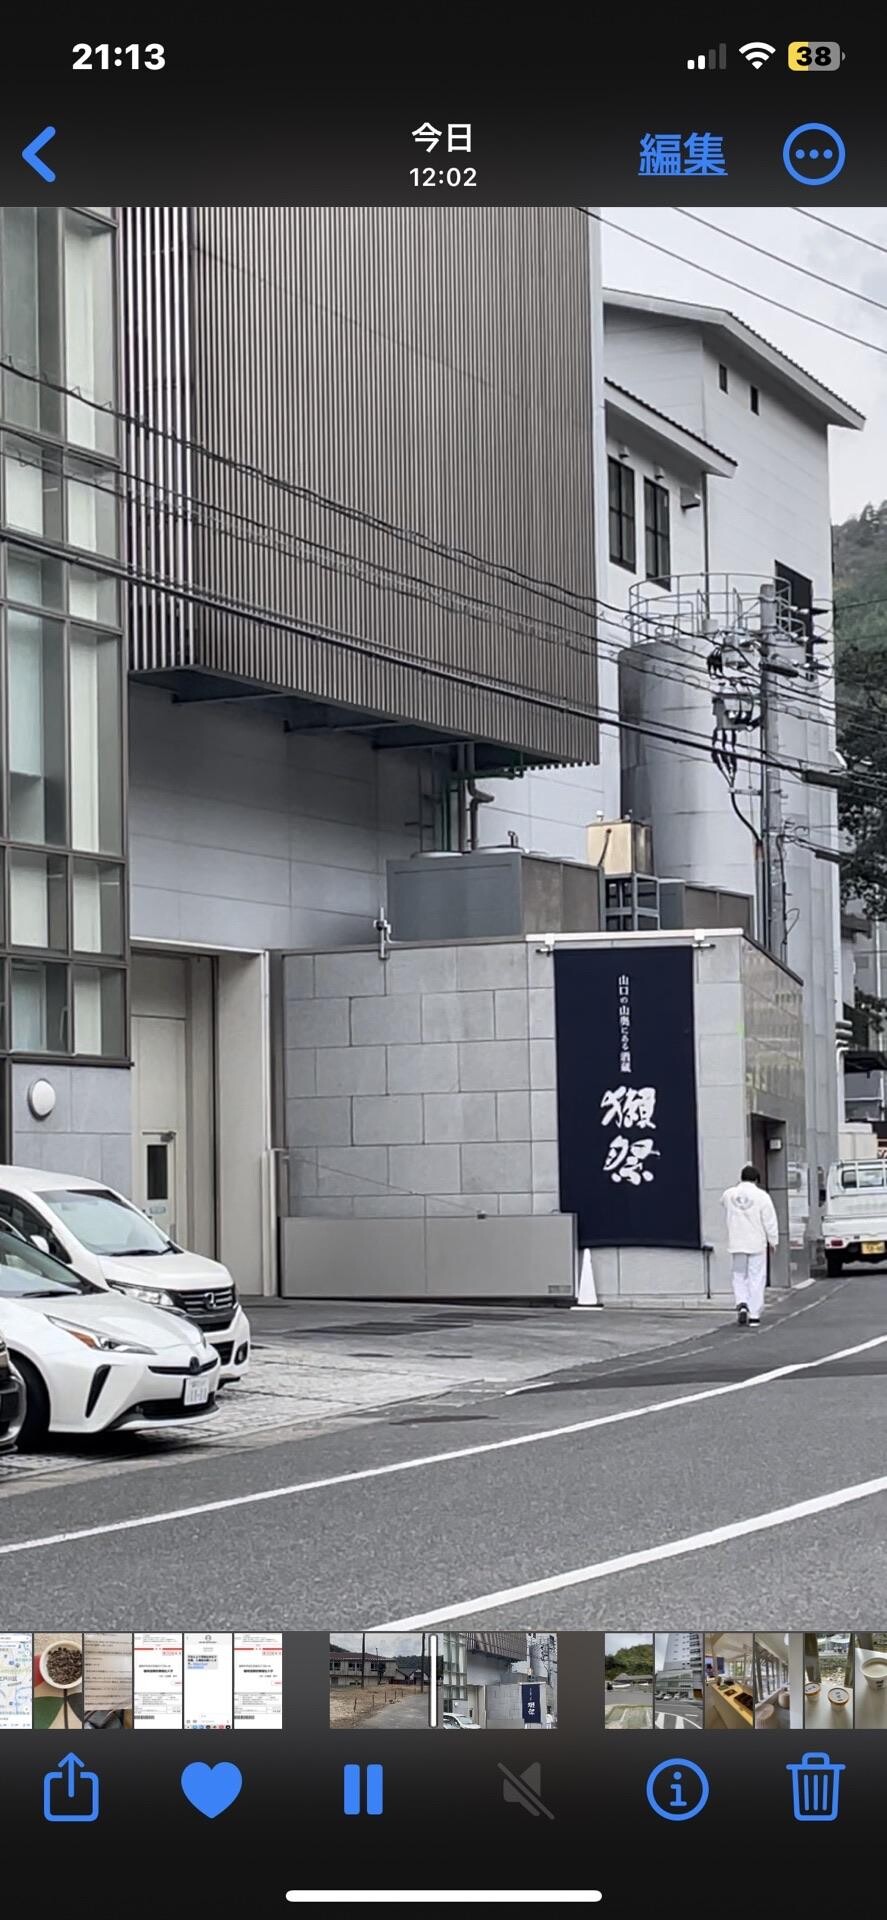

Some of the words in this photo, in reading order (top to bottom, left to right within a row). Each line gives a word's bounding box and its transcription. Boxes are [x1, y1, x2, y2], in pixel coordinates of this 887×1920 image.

[618, 974, 632, 1073] 山口の山奥にある酒蔵
